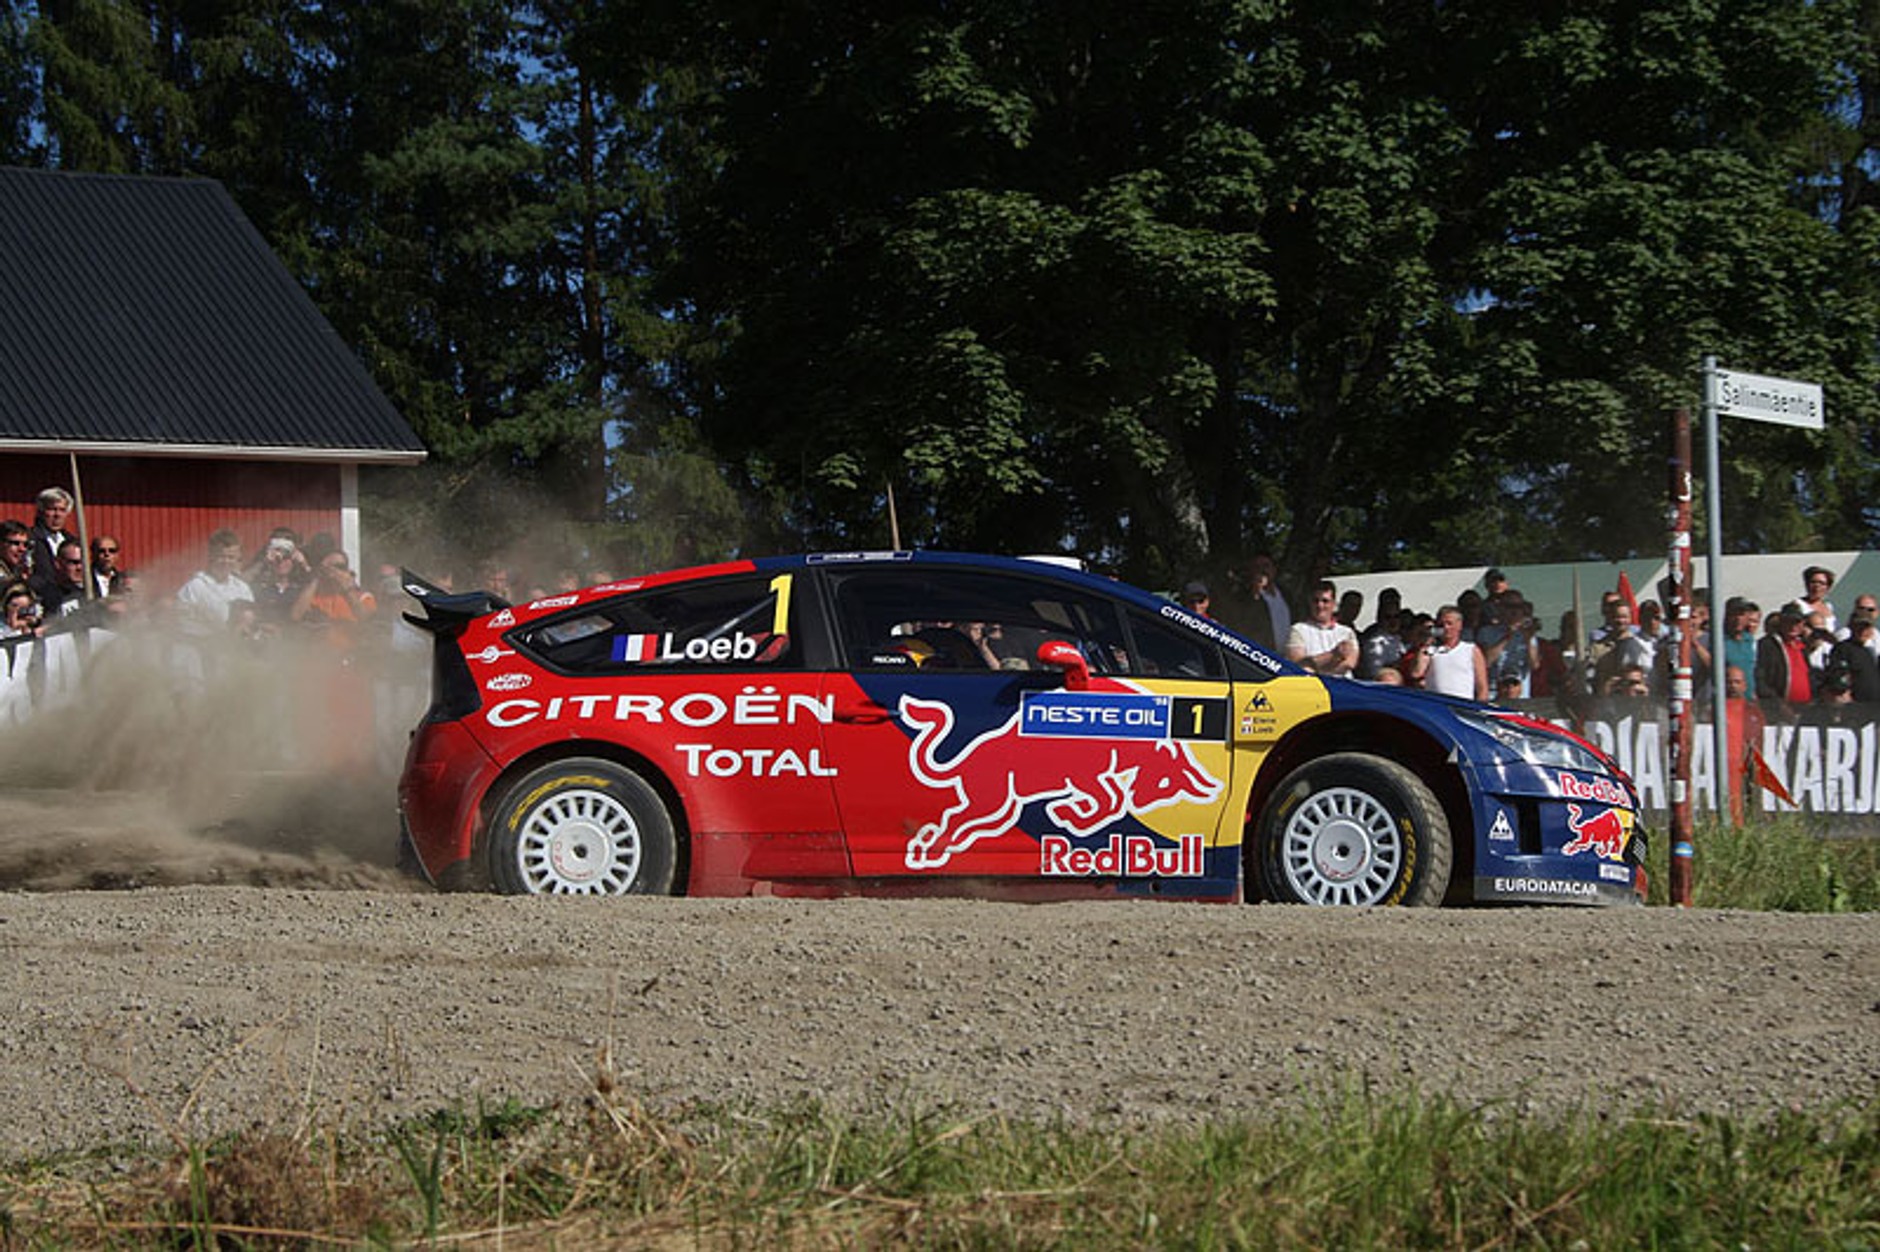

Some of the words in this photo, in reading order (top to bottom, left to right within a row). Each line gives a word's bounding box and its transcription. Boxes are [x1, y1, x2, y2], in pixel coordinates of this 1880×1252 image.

[1722, 381, 1816, 418] Salinmäentie
[769, 573, 793, 636] 1
[662, 632, 757, 662] Loeb
[486, 686, 835, 727] CITROËN
[1028, 705, 1121, 725] NESTE
[1125, 709, 1165, 727] OIL
[1191, 704, 1204, 735] 1
[676, 743, 838, 778] TOTAL
[1558, 770, 1604, 800] Red
[1041, 835, 1121, 877] Red
[1126, 834, 1204, 877] Bull
[1494, 878, 1598, 895] EURODATACAR
